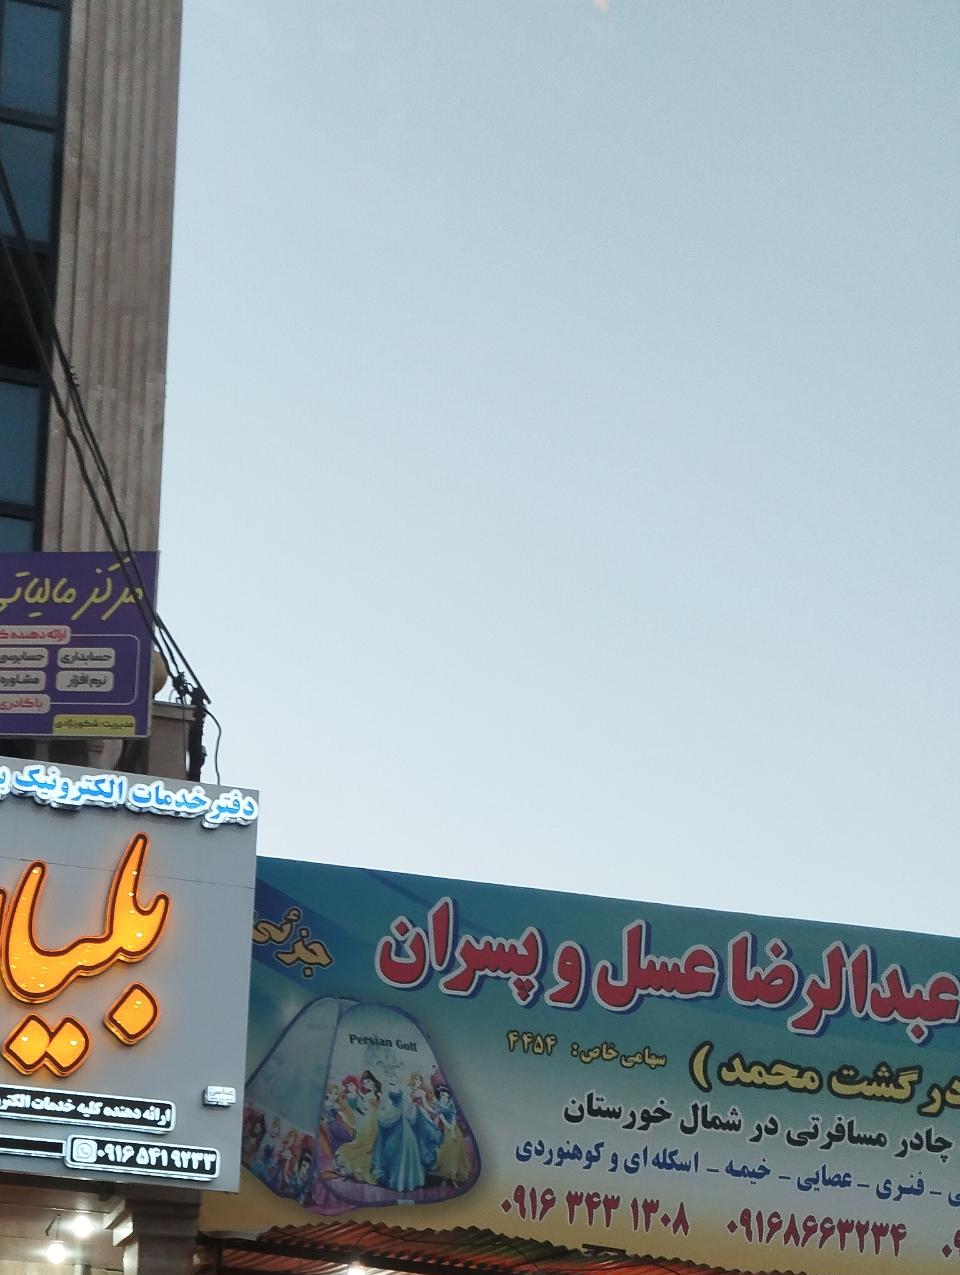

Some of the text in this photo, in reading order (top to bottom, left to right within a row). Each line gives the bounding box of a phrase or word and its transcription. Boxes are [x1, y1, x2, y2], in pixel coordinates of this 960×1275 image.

[70, 556, 144, 621] مرکز
[59, 652, 112, 665] حسابداری
[11, 764, 127, 809] الکترونیک
[127, 780, 210, 817] خدمات
[203, 788, 259, 828] دفتر
[375, 896, 960, 1044] عبدالرضا عسل و پسران
[349, 1034, 393, 1048] Persian
[506, 1029, 558, 1057] ۴۴۵۴
[618, 1046, 668, 1069] سهامی
[31, 1096, 76, 1112] خدمات
[76, 1101, 103, 1117] کلیه
[103, 1106, 142, 1119] دهنده
[679, 1102, 743, 1136] شمال
[749, 1117, 780, 1143] در
[786, 1115, 889, 1150] مسافرتی
[98, 1143, 134, 1163] ۰۹۱۶
[515, 1140, 605, 1165] کوهنوردی
[894, 1127, 954, 1163] چادر
[608, 1153, 620, 1174] و
[725, 1156, 772, 1182] خیمه
[797, 1165, 854, 1193] عصایی
[875, 1171, 926, 1202] فنری
[500, 1183, 690, 1237] ۰۹۱۶ ۳۴۳ ۱۳۰۸
